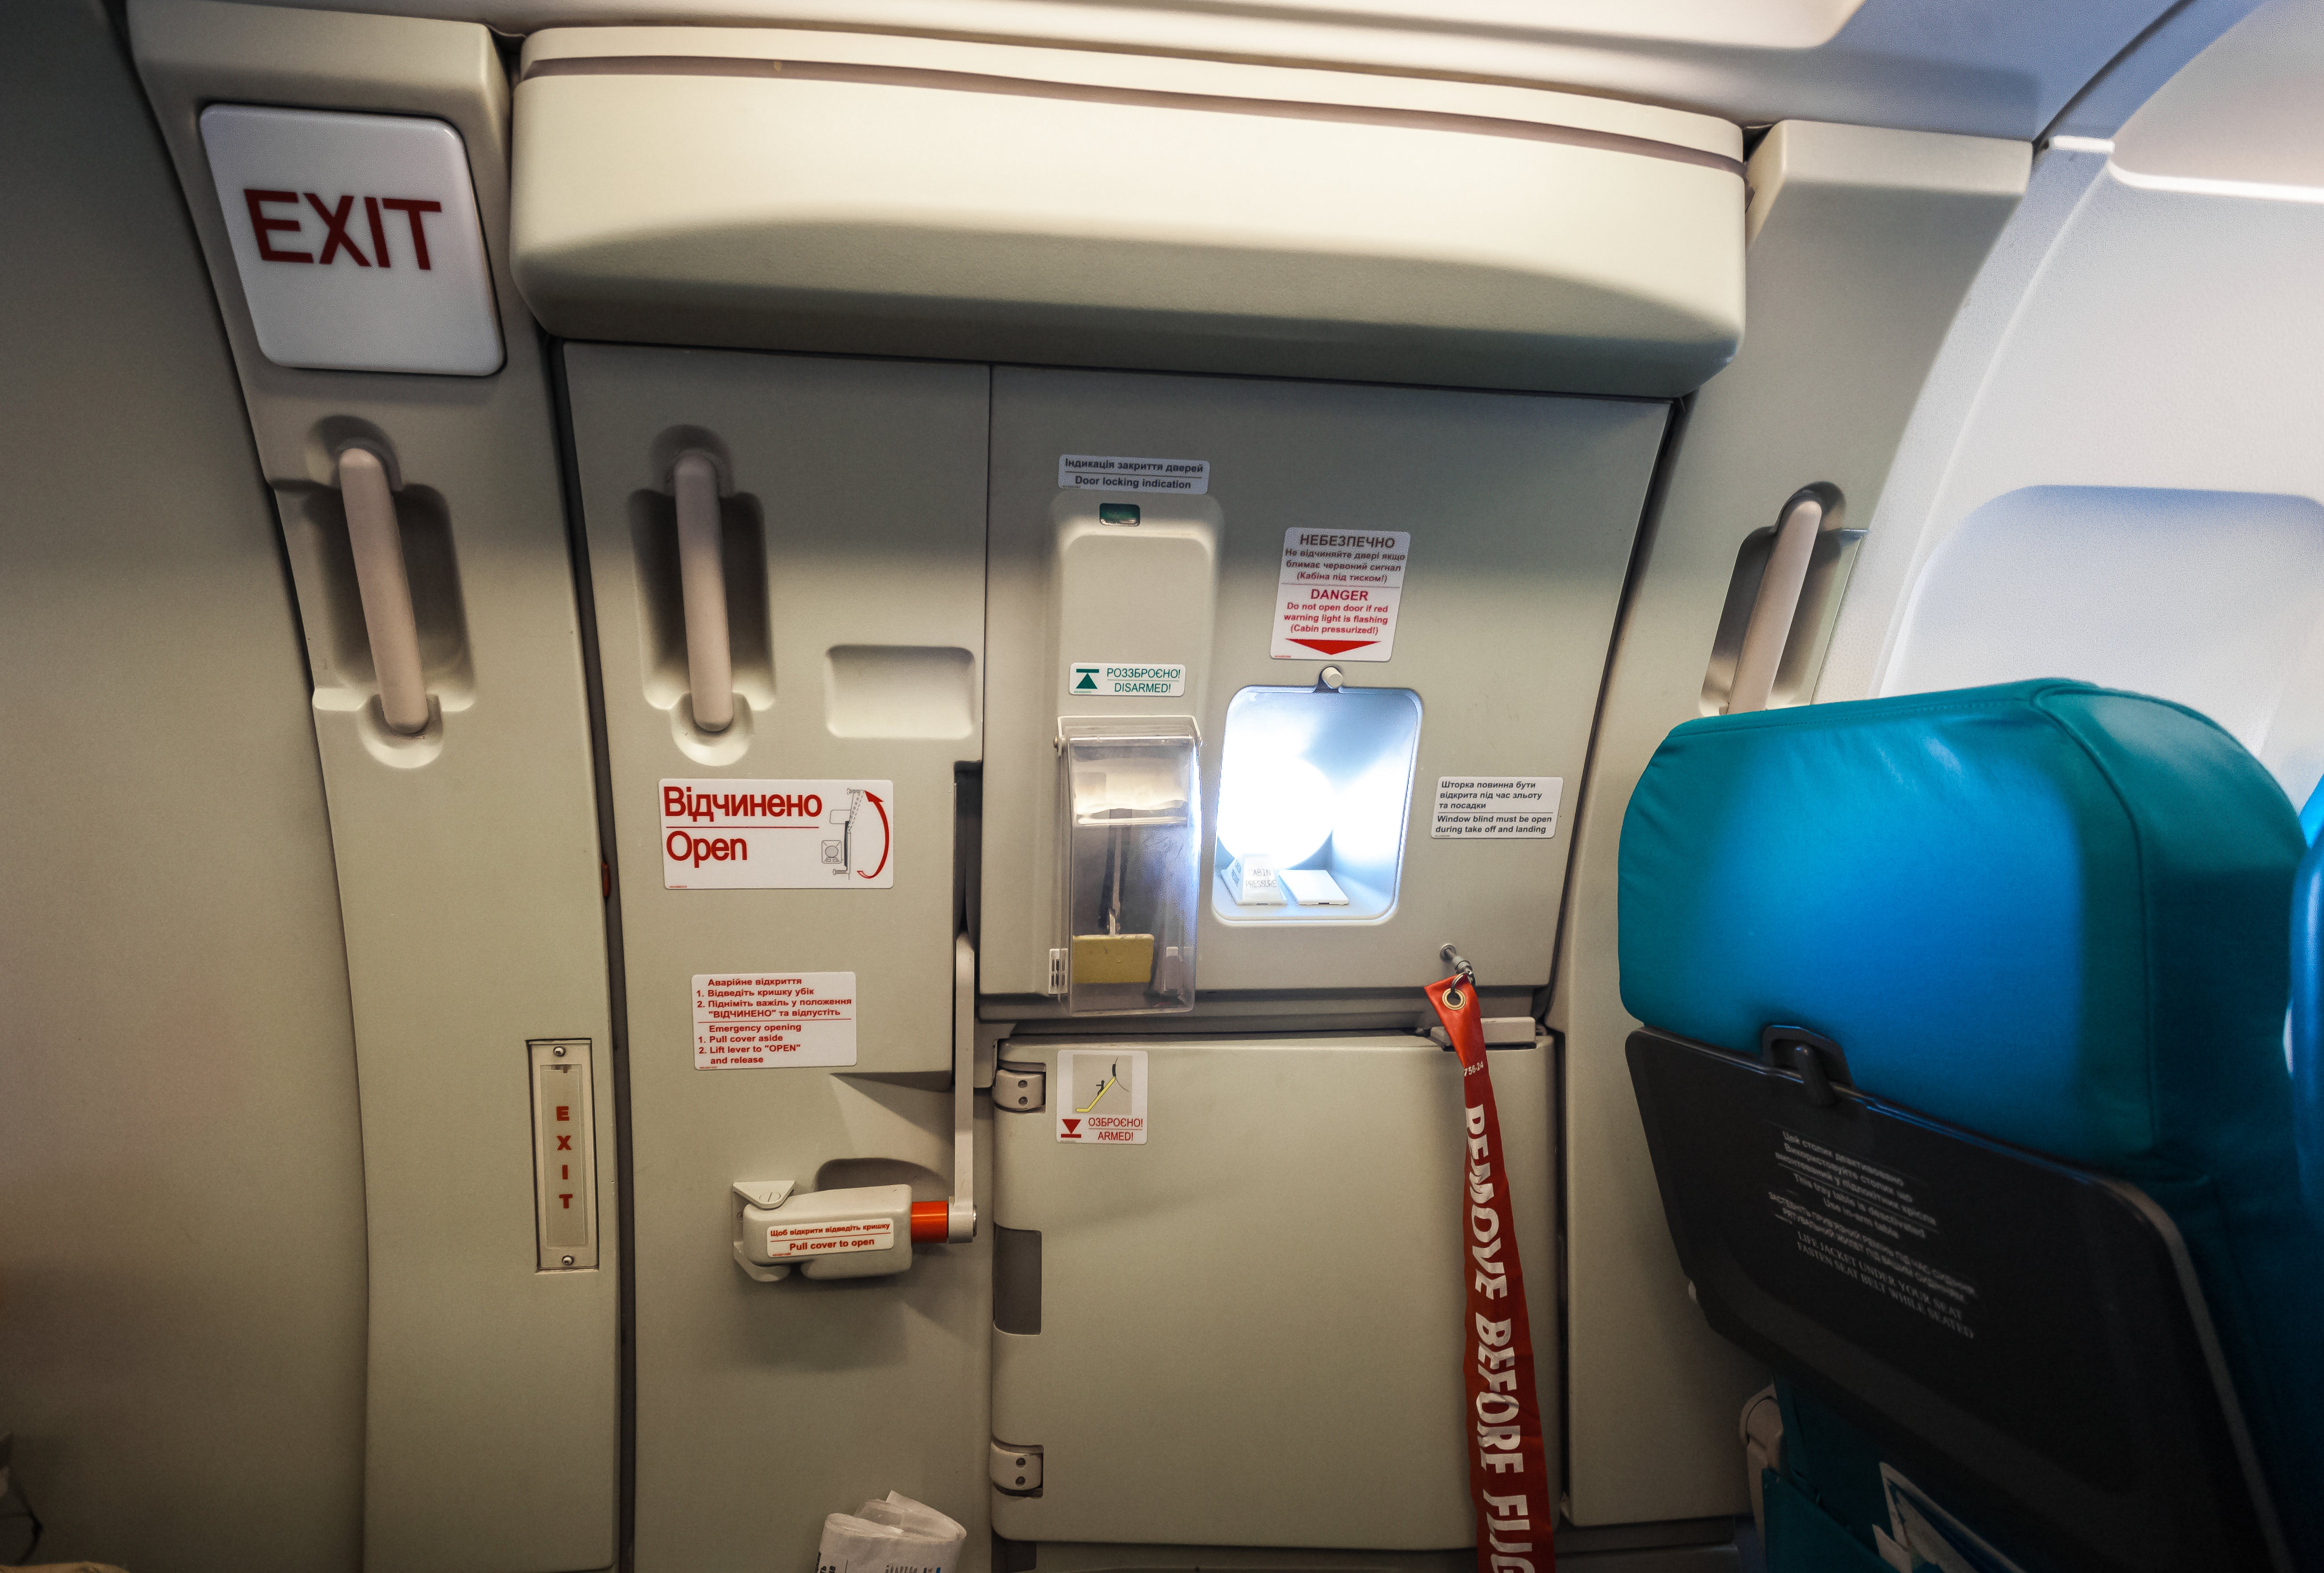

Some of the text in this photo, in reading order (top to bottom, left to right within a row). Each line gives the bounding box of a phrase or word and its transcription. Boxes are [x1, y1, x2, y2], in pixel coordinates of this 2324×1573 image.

[244, 189, 442, 271] EXIT
[1065, 458, 1203, 474] Індикація закриття дверей
[1075, 475, 1191, 489] Door locking indication
[1300, 534, 1395, 548] НЕБЕЗПЕЧНО
[1300, 550, 1351, 558] відчиняйте
[1354, 552, 1379, 560] двері
[1286, 560, 1320, 568] блимає
[1323, 563, 1367, 571] червоний
[1297, 572, 1330, 580] (Кабіна
[1350, 576, 1387, 584] тиском!)
[1310, 588, 1369, 601] DANGER
[1284, 614, 1318, 623] warning
[1322, 614, 1341, 623] light
[1354, 615, 1388, 625] flashing
[1291, 624, 1379, 636] (Cabin pressurized!)
[1107, 668, 1180, 678] РОЗЗБРОЄНО!
[1115, 683, 1171, 693] DISARMED!
[1442, 781, 1474, 789] Шторка
[1516, 781, 1536, 789] бути
[1440, 791, 1477, 799] відкрита
[664, 786, 822, 822] Відчинено
[1436, 826, 1462, 834] during
[666, 831, 747, 868] Open
[1249, 868, 1271, 876] CABIN
[1245, 880, 1277, 888] PRESSURE
[708, 978, 802, 987] Аварійне відкриття
[708, 989, 754, 997] Відведіть
[758, 989, 792, 997] кришку
[795, 988, 814, 996] убік
[708, 1000, 753, 1008] Підніміть
[709, 1009, 776, 1019] "ВІДЧИНЕНО"
[792, 1009, 840, 1017] відпустіть
[709, 1024, 801, 1034] Emergency opening
[765, 1044, 800, 1052] "OPEN"
[1464, 1061, 1483, 1076] 756-24
[1088, 1117, 1143, 1127] ОЗБРОЄНО!
[1098, 1131, 1133, 1141] ARMED!
[556, 1106, 573, 1208] EXIT
[790, 1227, 823, 1236] відкрити
[825, 1224, 860, 1233] відведіть
[863, 1223, 890, 1232] кришку
[790, 1238, 875, 1251] Pull cover to open
[1476, 1312, 1524, 1473] BEFORE
